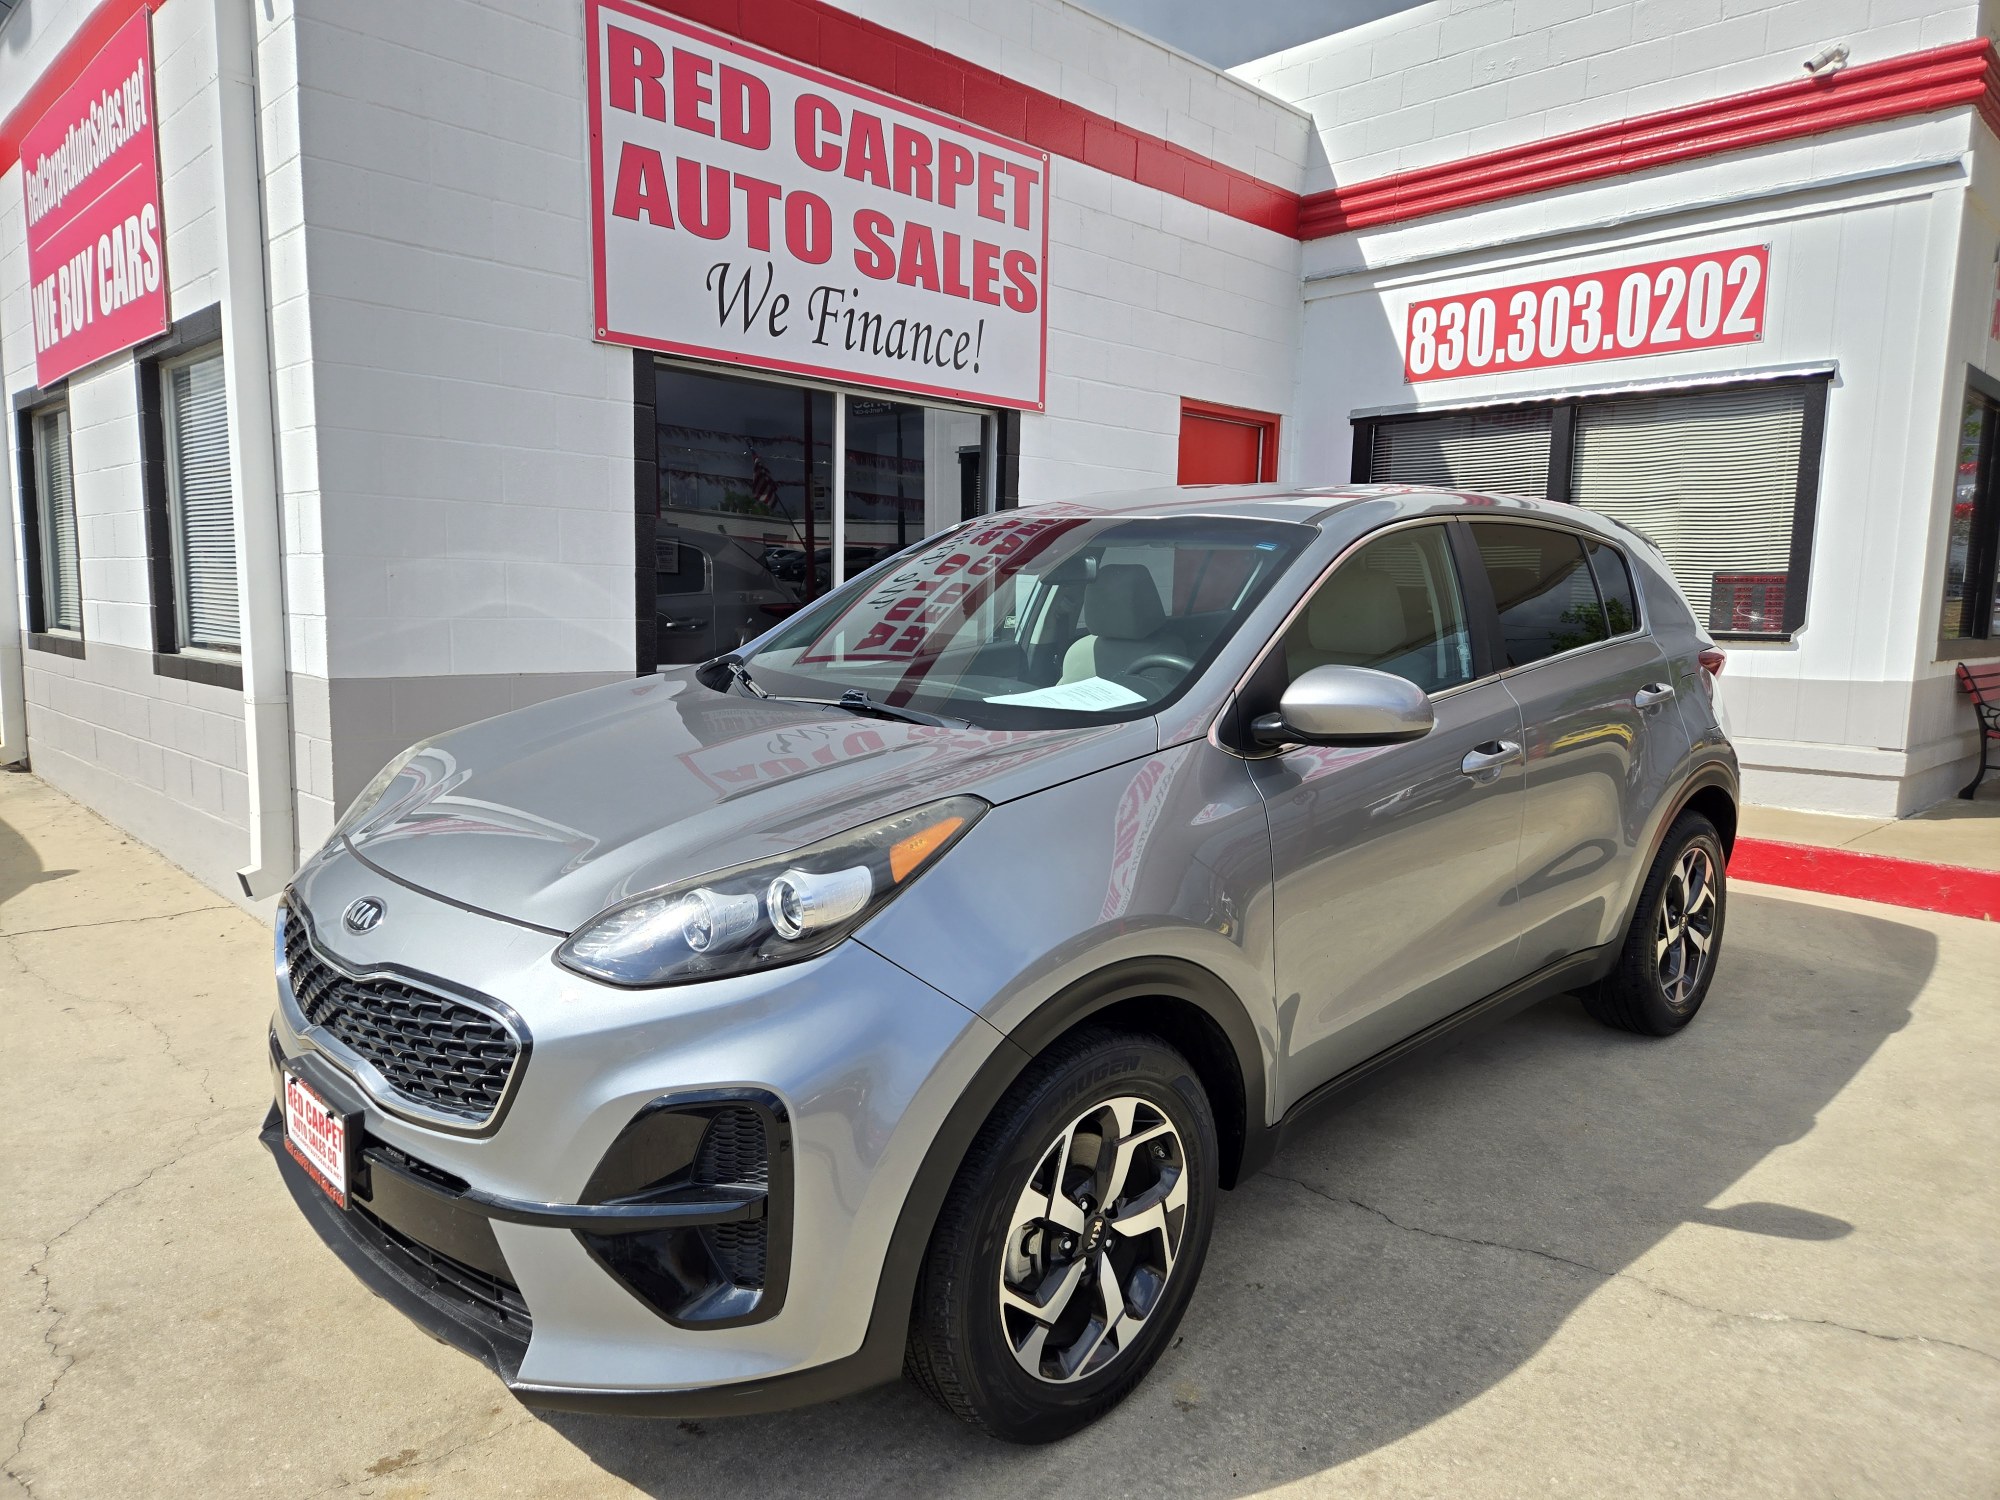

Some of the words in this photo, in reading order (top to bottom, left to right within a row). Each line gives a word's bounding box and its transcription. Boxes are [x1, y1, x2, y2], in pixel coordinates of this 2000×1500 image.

[25, 57, 147, 228] RedCarpetAutoSales.net
[606, 23, 772, 151] RED
[794, 93, 1040, 231] CARPET
[32, 273, 59, 354] WE
[58, 245, 94, 339] BUY
[97, 203, 160, 317] CARS
[611, 140, 833, 265] AUTO
[853, 208, 1038, 314] SALES
[705, 261, 790, 337] We
[807, 285, 985, 374] Finance!
[1408, 254, 1762, 375] 830.303.0202
[347, 900, 378, 929] KIA
[287, 1082, 304, 1118] RED
[305, 1099, 344, 1154] CARPET
[307, 1127, 327, 1159] SALES
[1087, 1221, 1103, 1250] KIA
